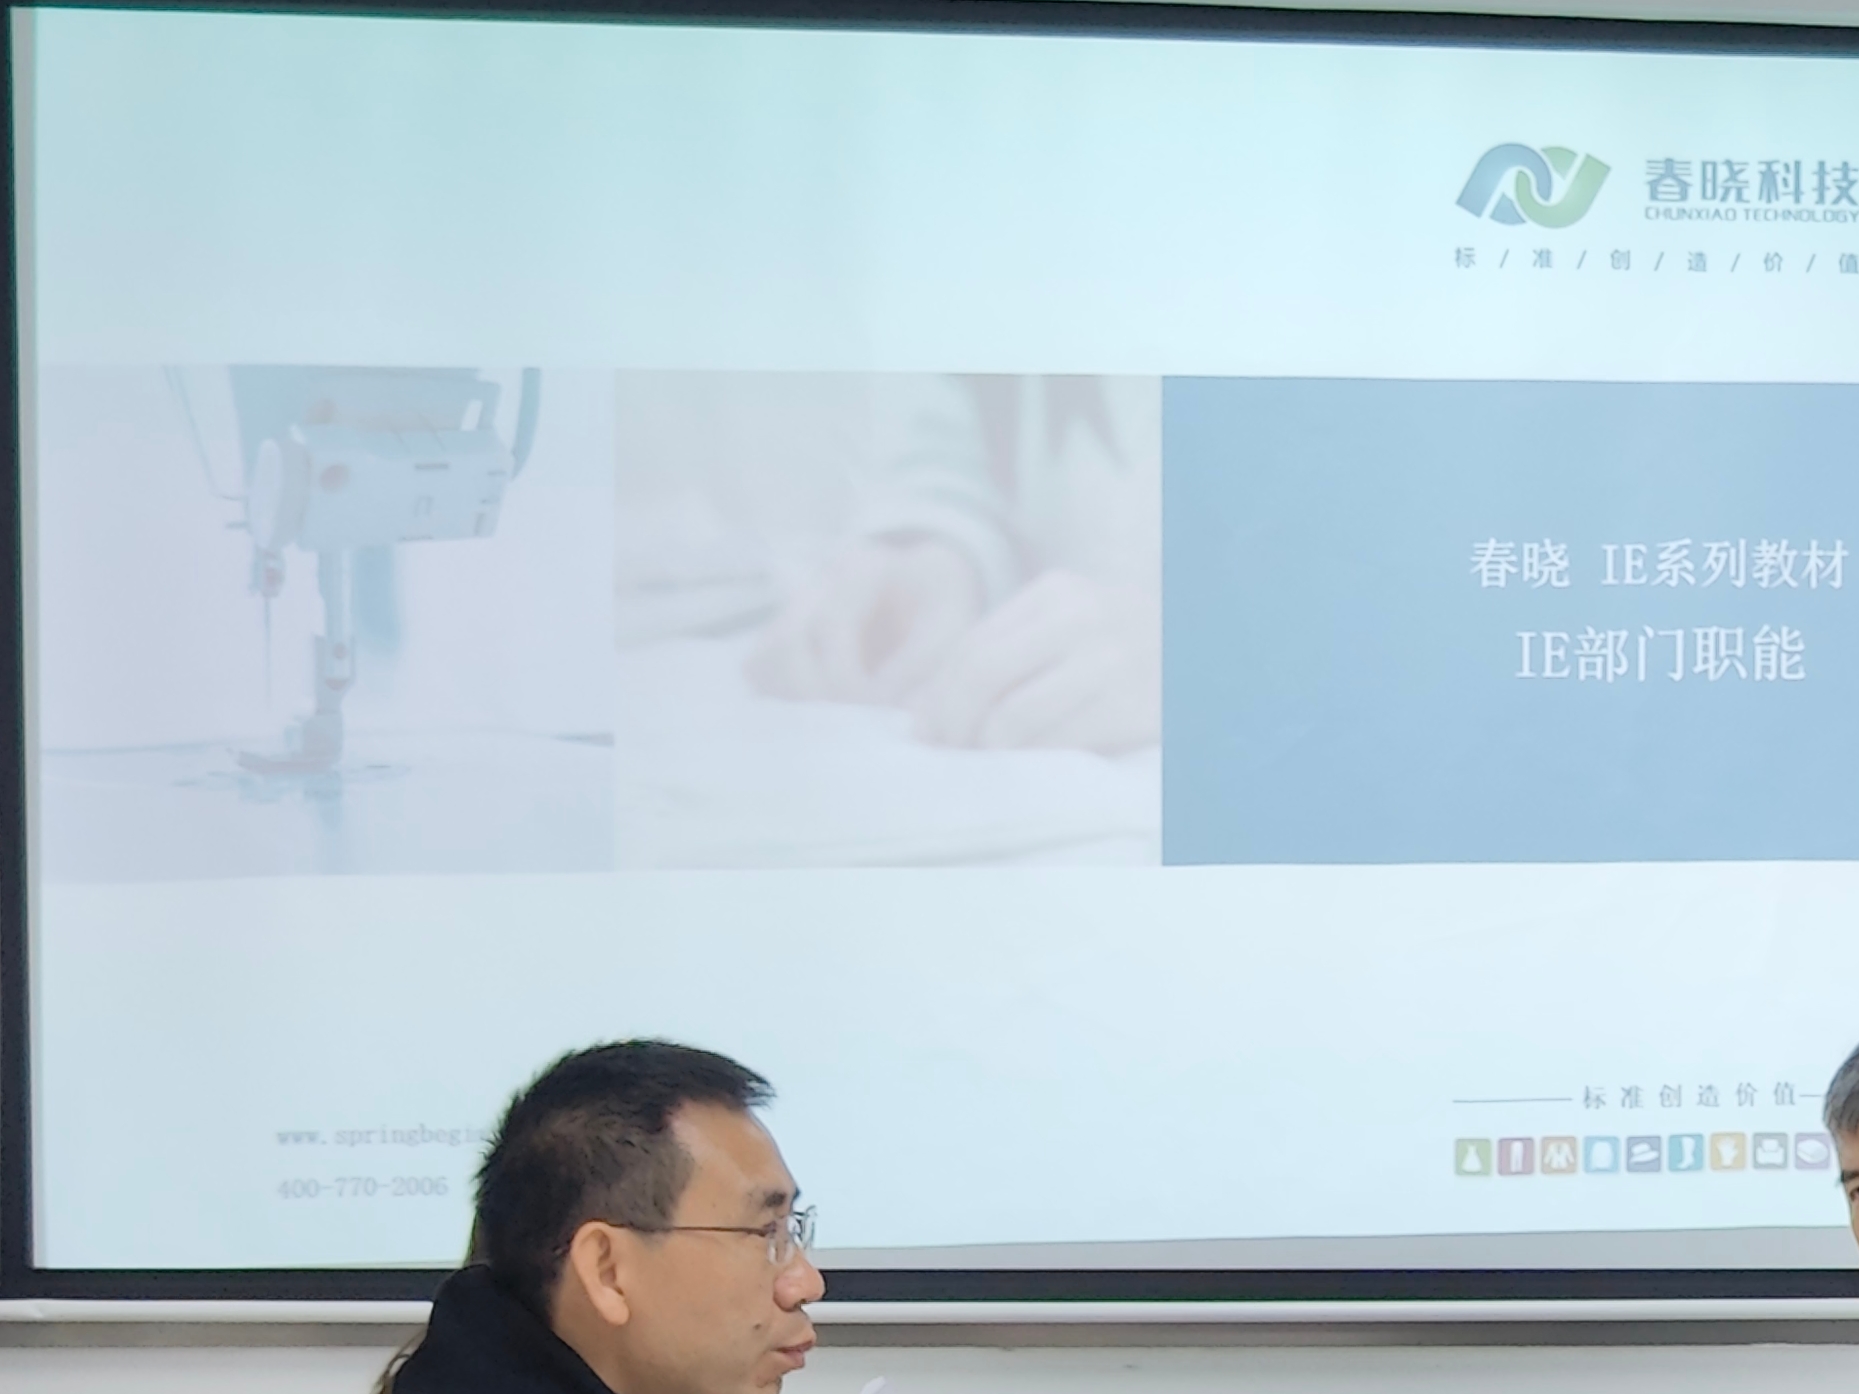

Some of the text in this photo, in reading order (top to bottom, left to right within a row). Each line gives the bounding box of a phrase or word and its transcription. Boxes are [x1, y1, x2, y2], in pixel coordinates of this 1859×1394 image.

[1645, 158, 1859, 207] 春晓科技
[1645, 207, 1859, 223] CHUNXIAO TECHNOLOGY
[1470, 537, 1849, 590] 春晓 IE系列教材
[1515, 625, 1807, 684] IE部门职能
[1583, 1081, 1796, 1110] 标准创造价值
[276, 1176, 450, 1200] 400-770-2006
